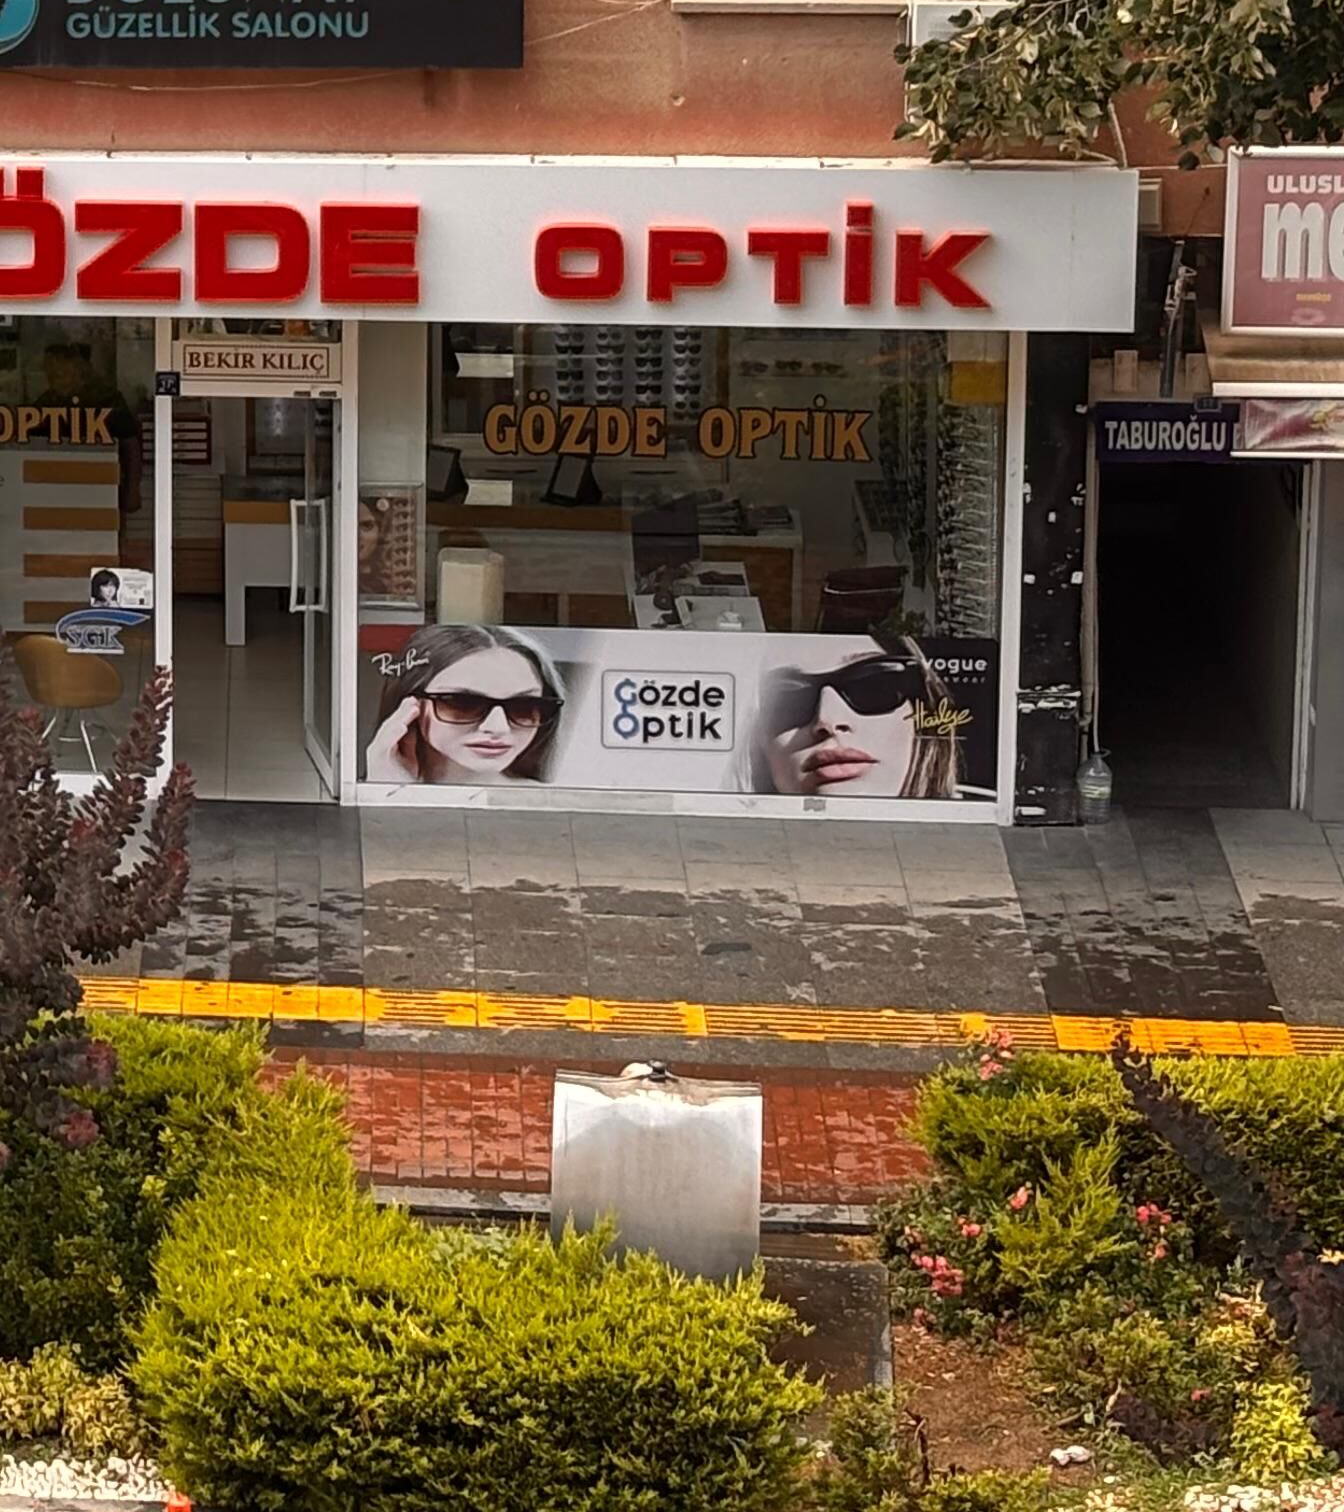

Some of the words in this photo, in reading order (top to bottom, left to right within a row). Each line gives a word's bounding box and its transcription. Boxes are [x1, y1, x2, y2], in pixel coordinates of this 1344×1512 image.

[66, 5, 220, 38] GÜZELLİK
[231, 10, 369, 38] SALONU
[533, 202, 993, 310] OPTİK
[187, 347, 256, 369] BEKİR
[262, 351, 325, 375] KILIÇ
[483, 390, 667, 458] GÖZDE
[697, 394, 873, 462] OPTİK
[1105, 414, 1226, 451] TABUROĞLU
[613, 677, 726, 708] Gözde
[613, 710, 723, 743] Optik
